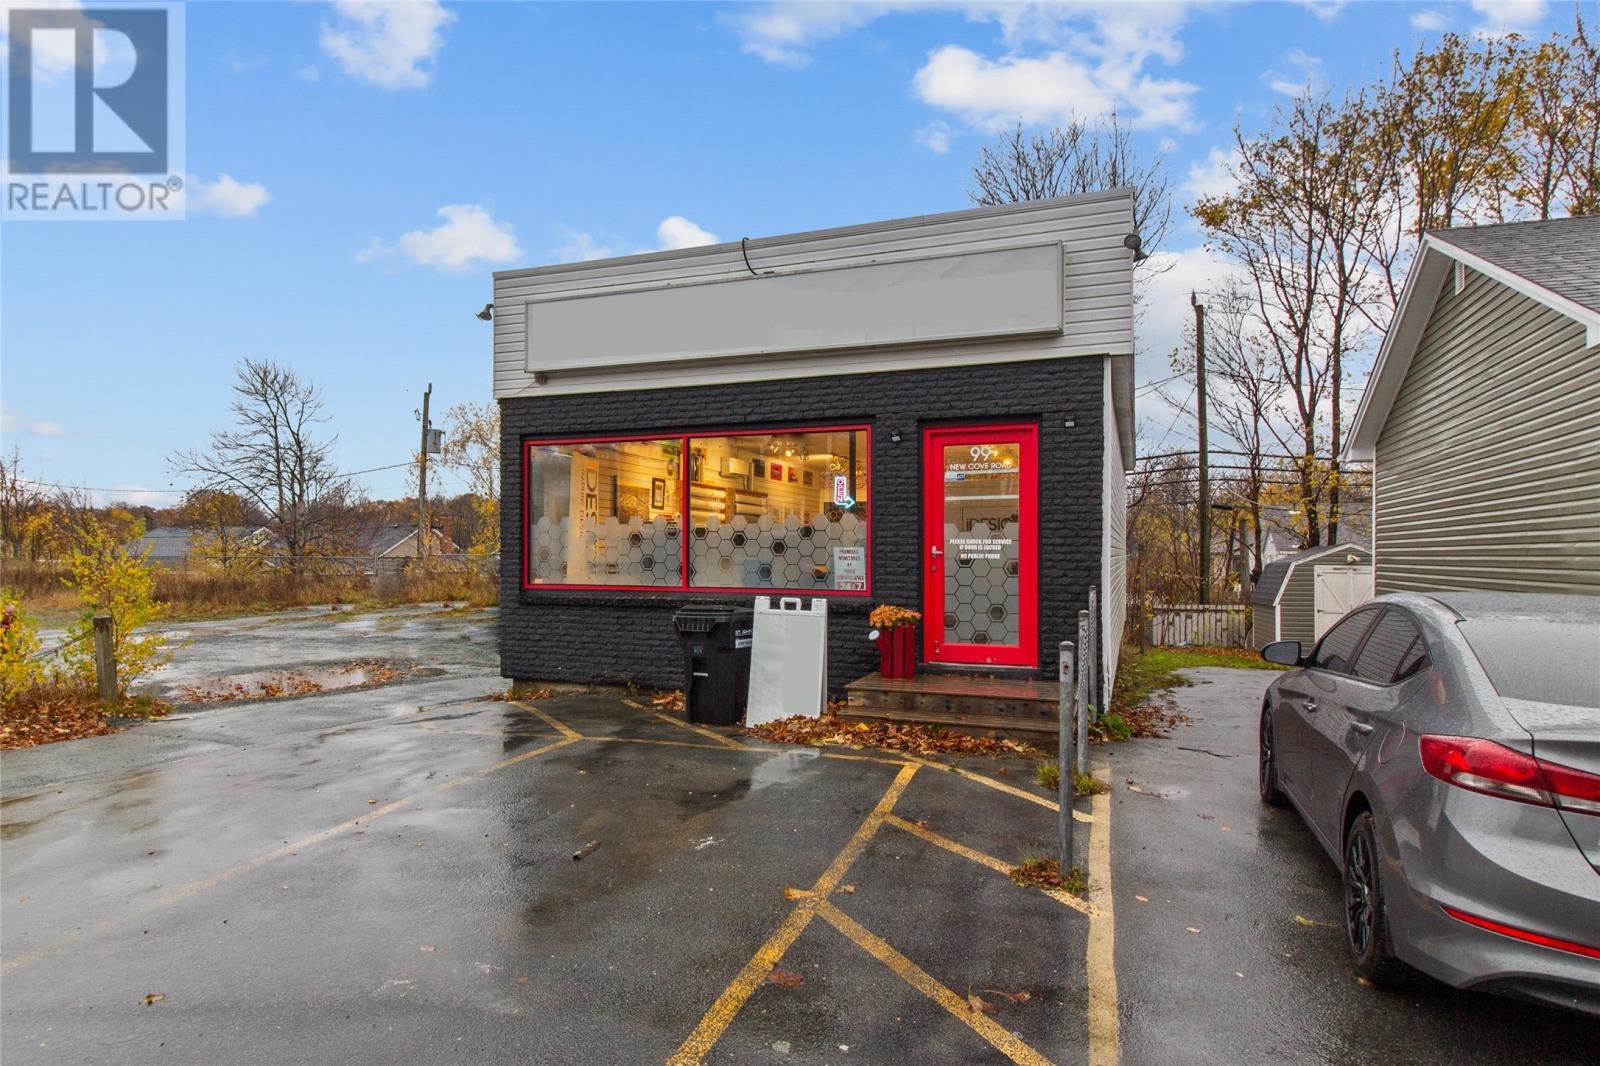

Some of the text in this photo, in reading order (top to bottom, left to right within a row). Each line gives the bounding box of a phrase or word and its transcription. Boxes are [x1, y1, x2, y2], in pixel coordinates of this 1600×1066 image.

[970, 446, 992, 461] 99
[950, 463, 966, 471] NEW
[967, 462, 989, 470] COVE
